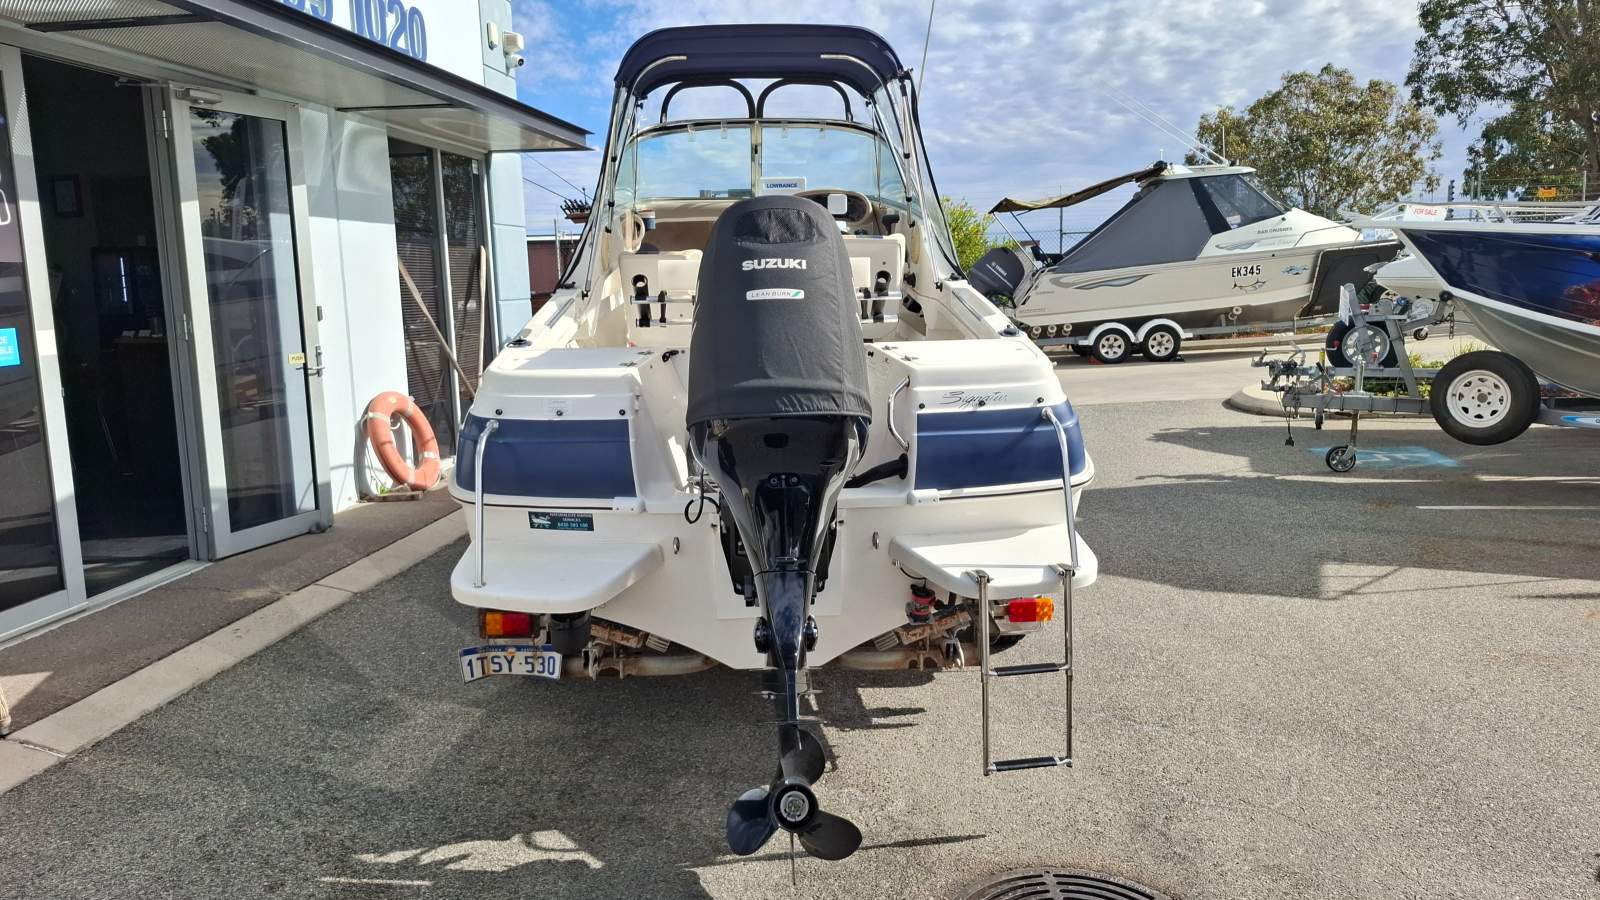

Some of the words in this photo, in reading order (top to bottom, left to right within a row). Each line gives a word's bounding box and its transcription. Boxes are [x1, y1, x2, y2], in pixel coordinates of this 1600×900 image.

[1424, 208, 1438, 216] SALE
[742, 258, 807, 271] SUZUKI
[1231, 264, 1261, 278] EK345
[751, 290, 771, 298] LEAN
[771, 289, 791, 297] BURN
